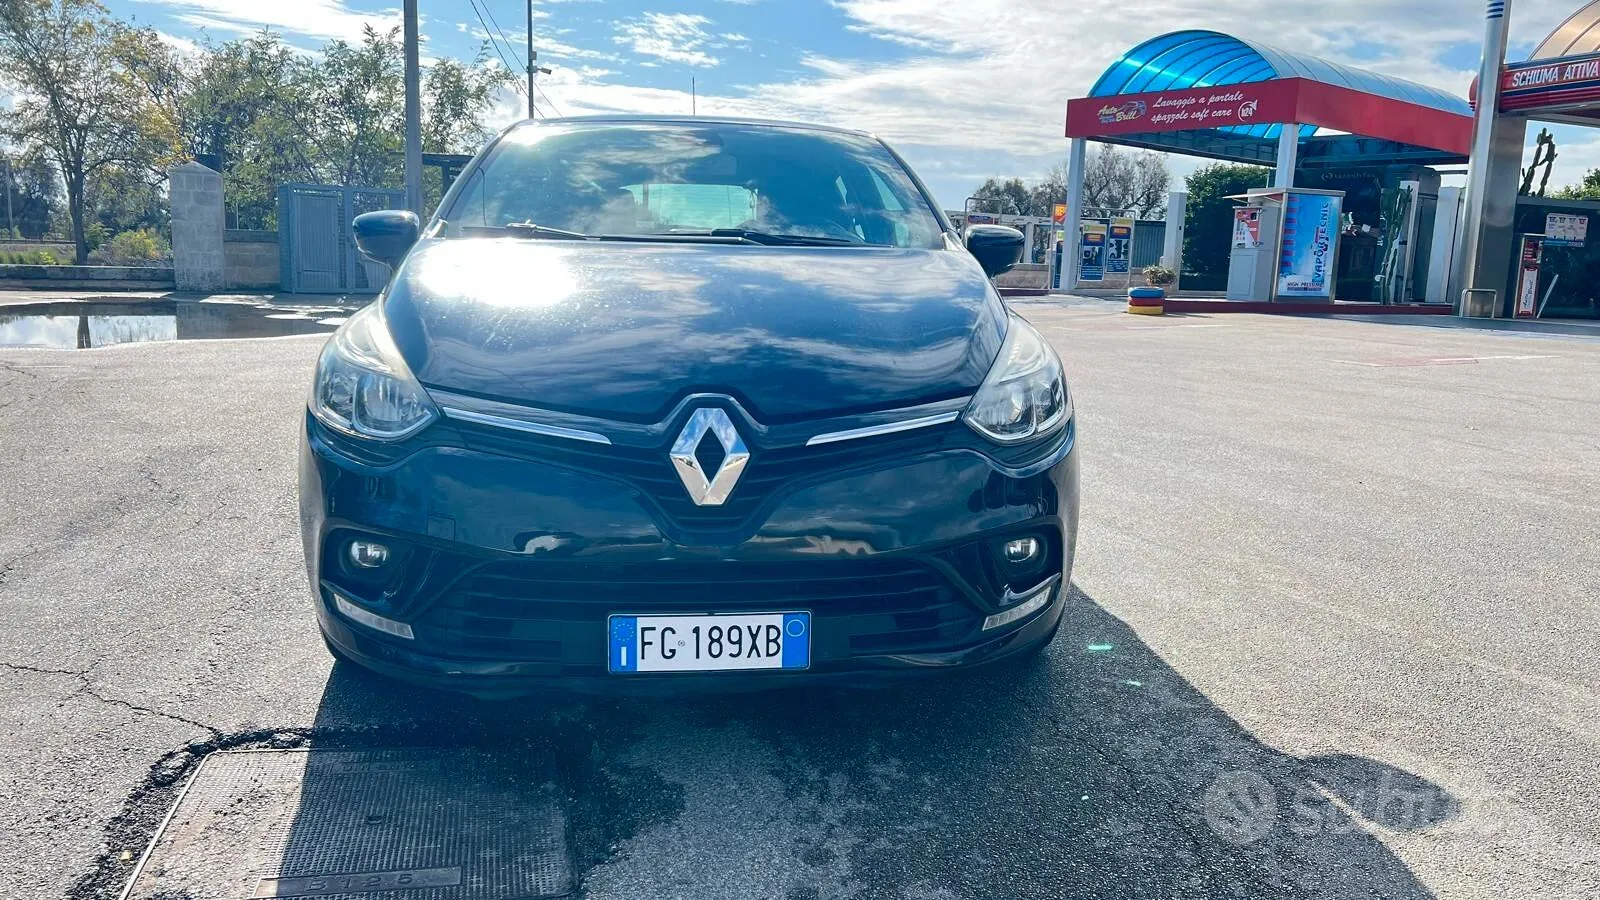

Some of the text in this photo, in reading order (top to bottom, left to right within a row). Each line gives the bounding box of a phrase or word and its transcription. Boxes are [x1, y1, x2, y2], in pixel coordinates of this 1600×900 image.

[1512, 61, 1599, 87] SCHIUMA ATTIVA
[1153, 96, 1196, 110] Lavaggio
[1208, 91, 1244, 107] portale
[1116, 110, 1137, 122] Brill
[1150, 108, 1232, 125] spazzole soft care
[641, 625, 781, 659] FG 189XB
